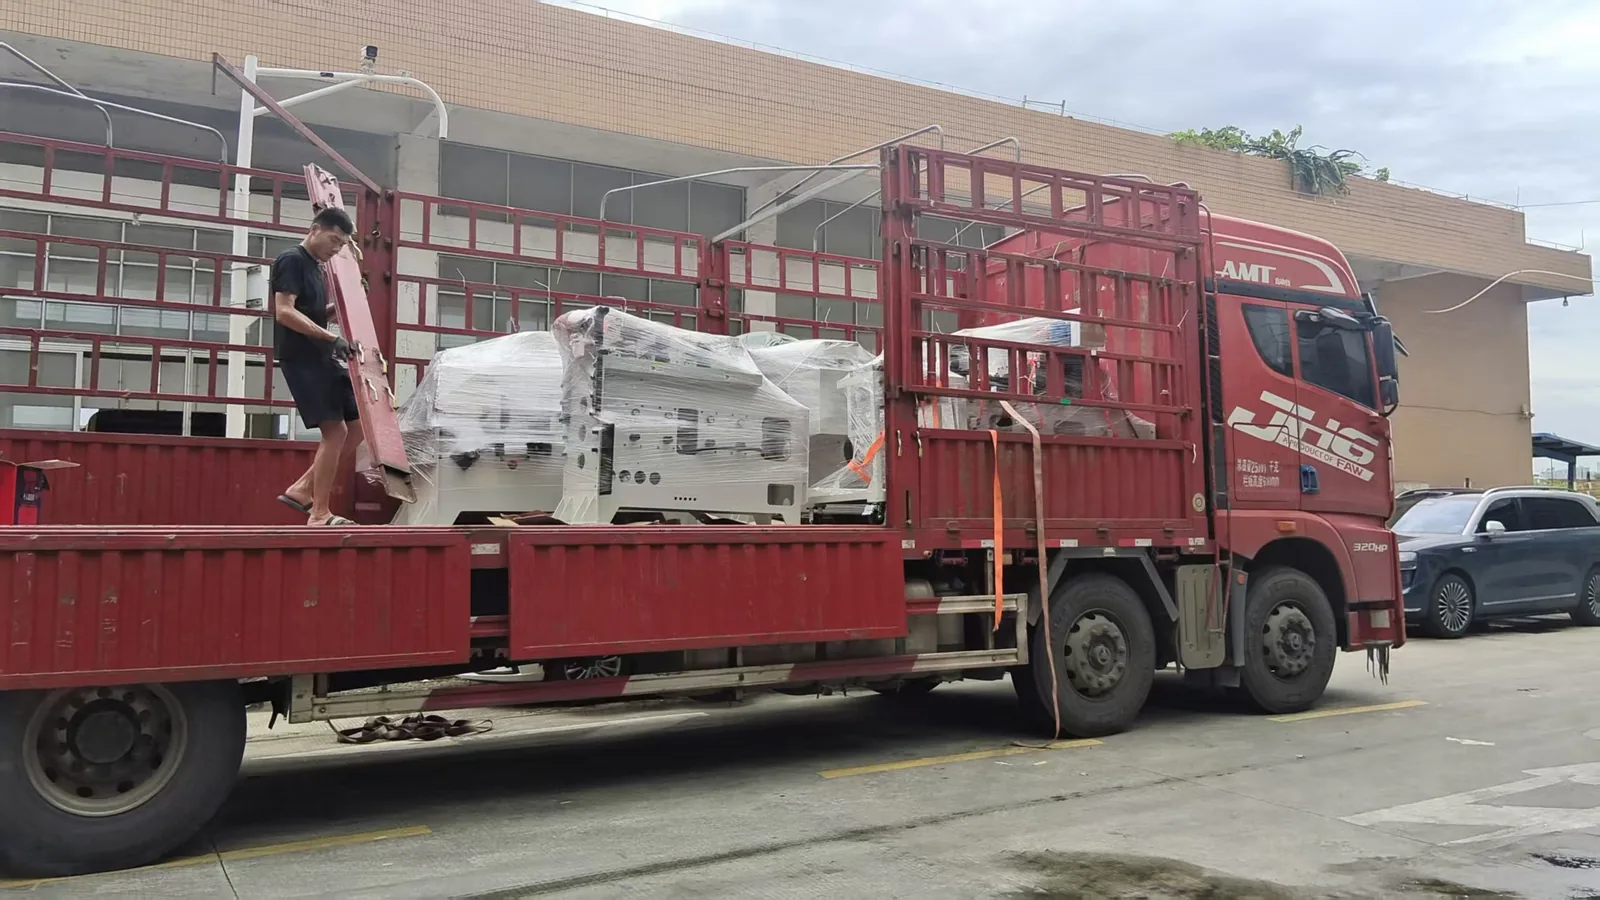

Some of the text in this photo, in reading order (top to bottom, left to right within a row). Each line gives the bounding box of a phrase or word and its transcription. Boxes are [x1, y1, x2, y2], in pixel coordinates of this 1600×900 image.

[1215, 260, 1276, 283] AMT
[1289, 440, 1323, 459] PRODUCT
[1323, 453, 1333, 463] OF
[1336, 458, 1364, 476] FAW
[1353, 542, 1388, 552] 320HP
